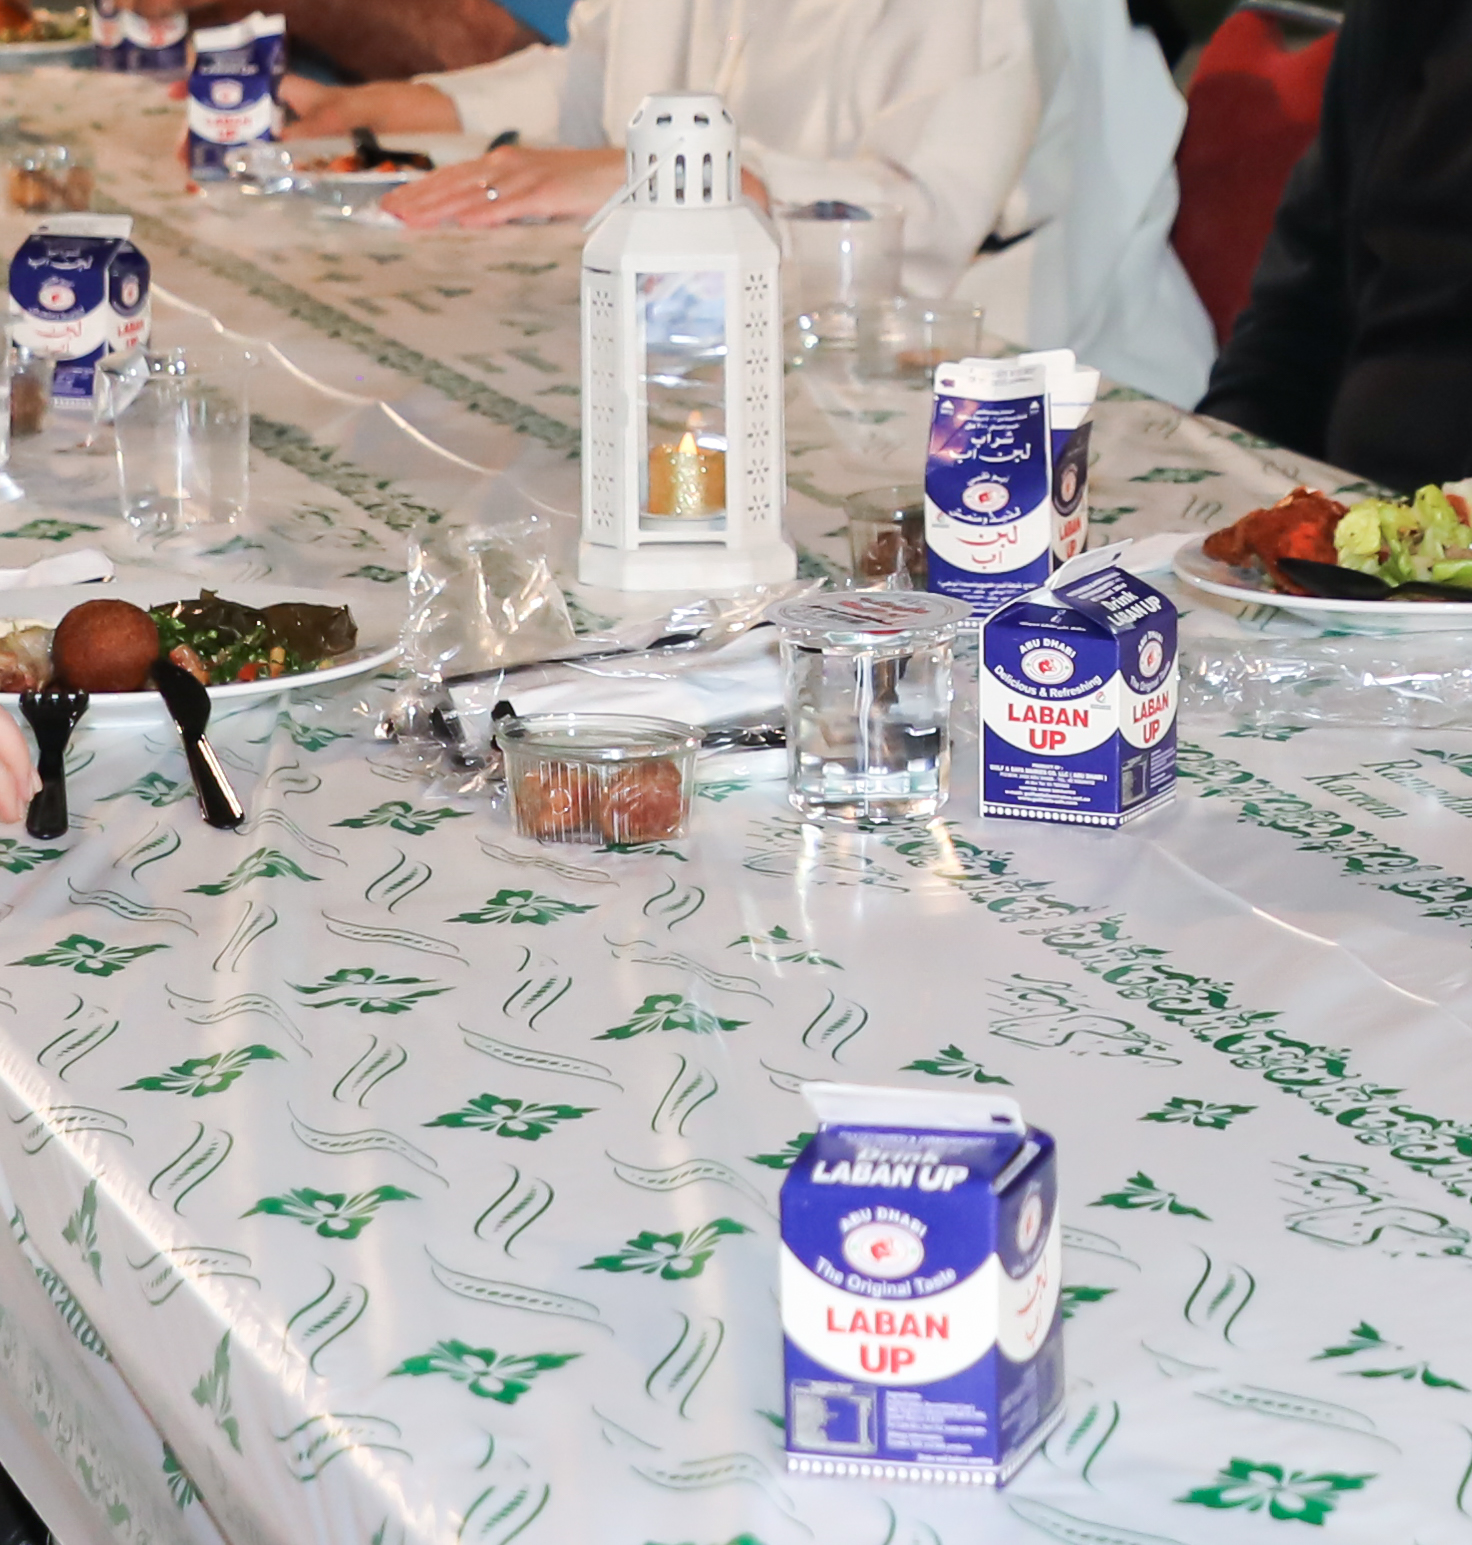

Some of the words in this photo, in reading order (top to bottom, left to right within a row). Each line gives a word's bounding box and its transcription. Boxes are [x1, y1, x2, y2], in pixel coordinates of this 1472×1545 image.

[979, 442, 1031, 463] لبن
[955, 524, 1018, 549] لبن
[1101, 590, 1139, 611] Drink
[1140, 595, 1162, 612] UP
[1019, 638, 1041, 654] ABU
[1042, 637, 1077, 658] DHABI
[994, 664, 1037, 696] Delicious
[1039, 687, 1048, 698] &
[1049, 674, 1103, 698] Refreshing
[1007, 703, 1090, 728] LABAN
[1132, 690, 1169, 724] LABAN
[1029, 728, 1067, 750] UP
[1143, 718, 1161, 743] UP
[1302, 773, 1408, 819] Kareem
[811, 1159, 917, 1188] LABAN
[917, 1163, 970, 1192] UP
[839, 1207, 873, 1234] ABU
[874, 1206, 928, 1238] DHABI
[815, 1255, 845, 1286] The
[847, 1272, 913, 1298] Original
[912, 1267, 958, 1295] Taste
[825, 1305, 950, 1340] LABAN
[859, 1343, 917, 1374] UP
